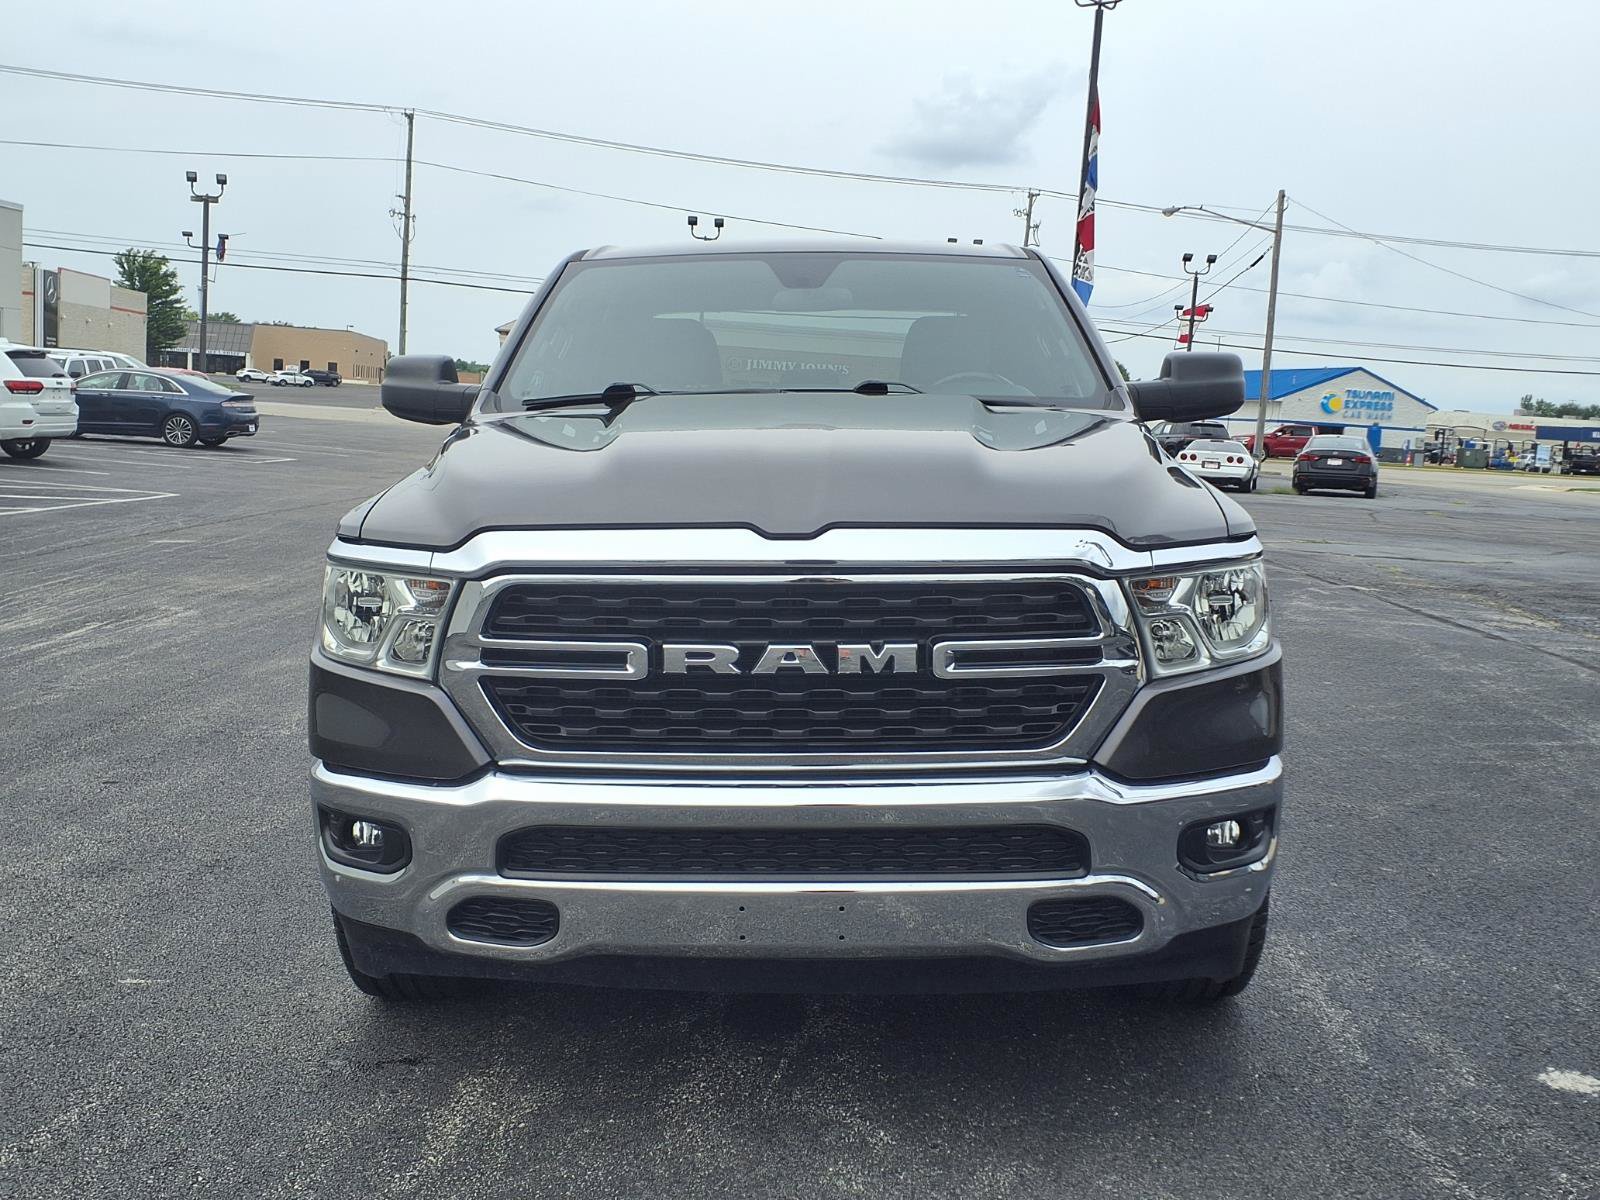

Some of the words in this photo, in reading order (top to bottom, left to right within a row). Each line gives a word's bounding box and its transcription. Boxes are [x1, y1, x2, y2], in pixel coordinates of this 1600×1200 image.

[746, 359, 797, 371] JIMMY
[1343, 399, 1394, 411] EXPRESS
[662, 643, 918, 675] RAM
